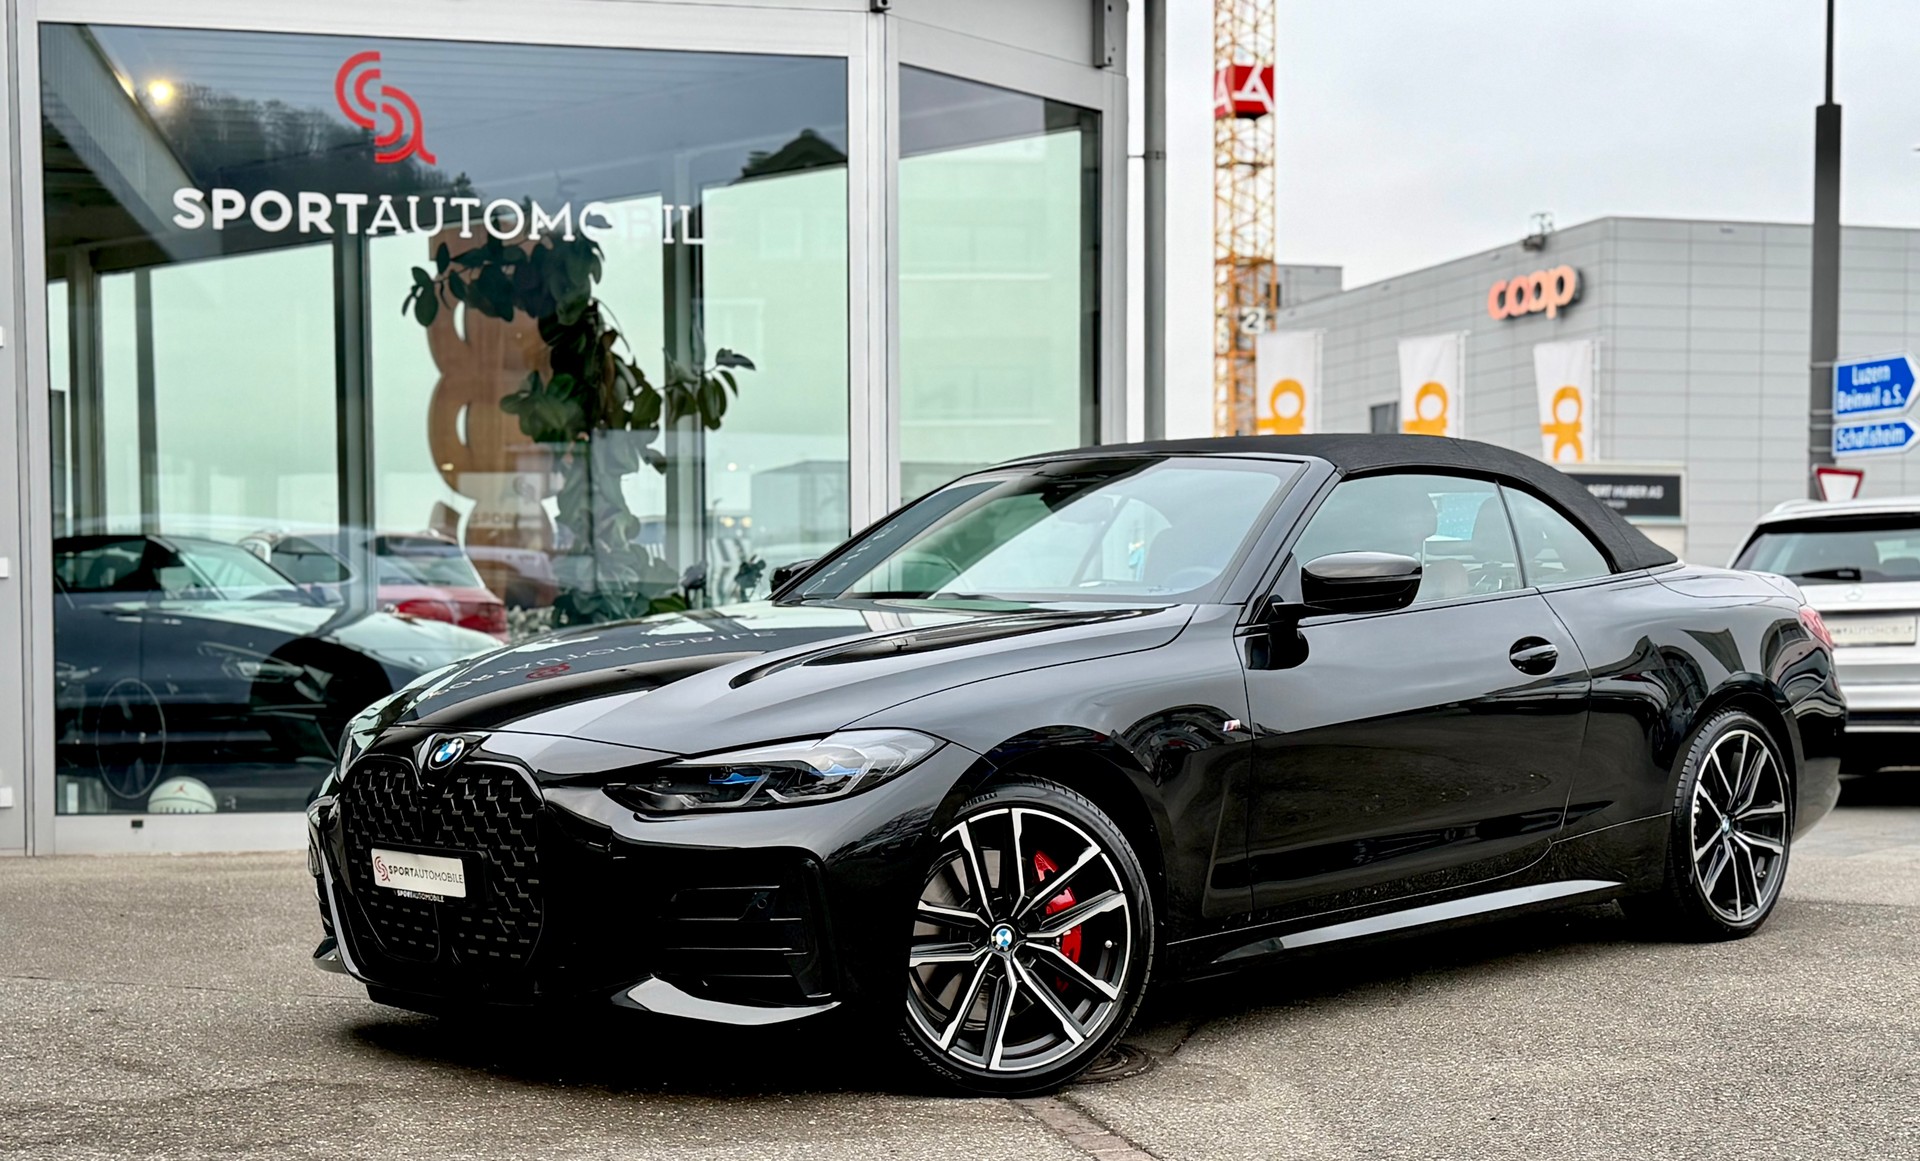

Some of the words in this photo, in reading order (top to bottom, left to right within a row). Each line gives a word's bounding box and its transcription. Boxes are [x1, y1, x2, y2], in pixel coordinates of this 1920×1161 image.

[1488, 265, 1576, 320] coop
[1851, 364, 1891, 386] Luzern
[388, 865, 464, 884] SPORTAUTOMOBILE
